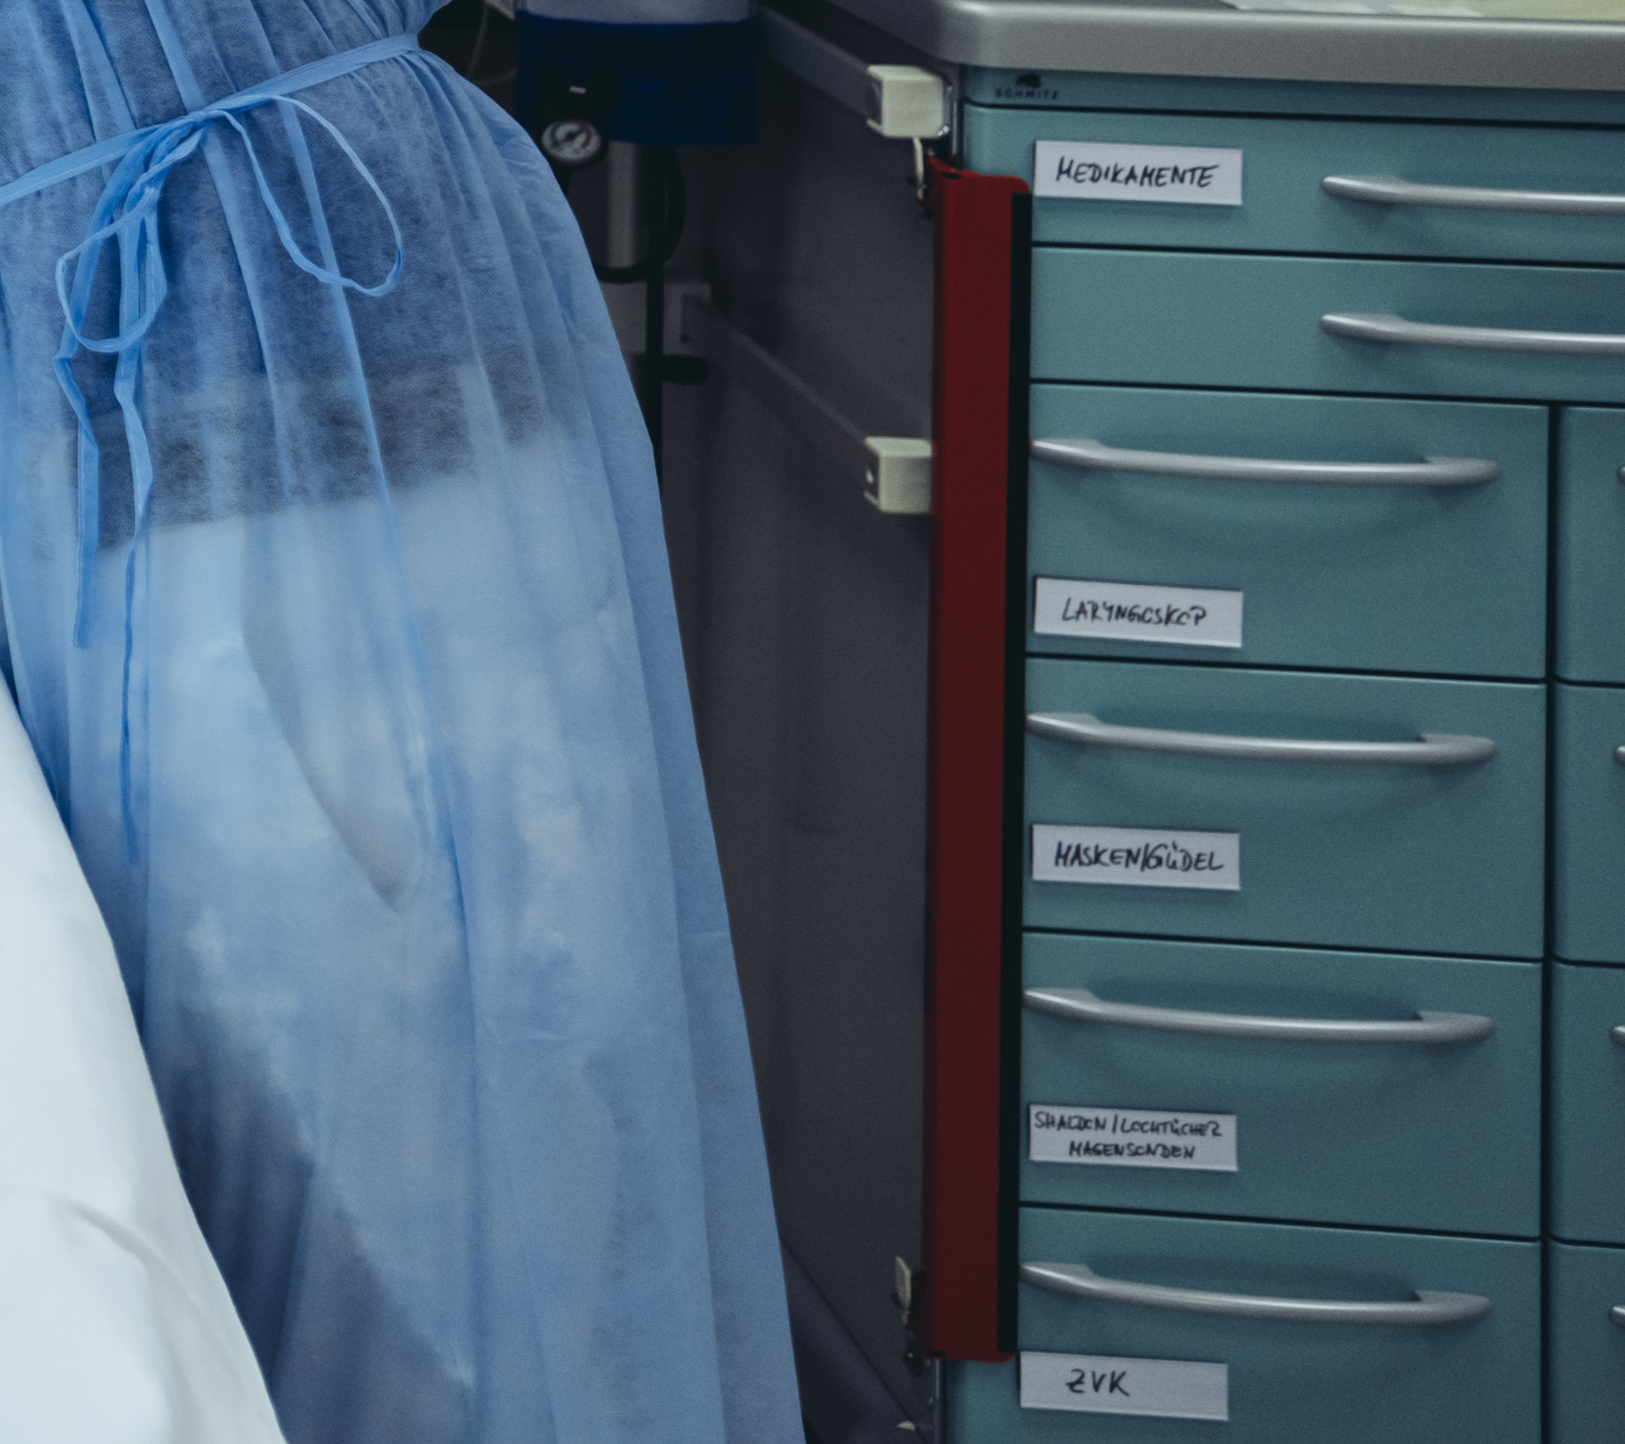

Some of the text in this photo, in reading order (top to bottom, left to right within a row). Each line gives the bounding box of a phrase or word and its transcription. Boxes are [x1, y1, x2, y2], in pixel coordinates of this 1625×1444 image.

[994, 87, 1061, 101] SCHMITZ
[1055, 155, 1220, 189] MEDIKAMENTE
[1065, 1367, 1131, 1397] ZVK
